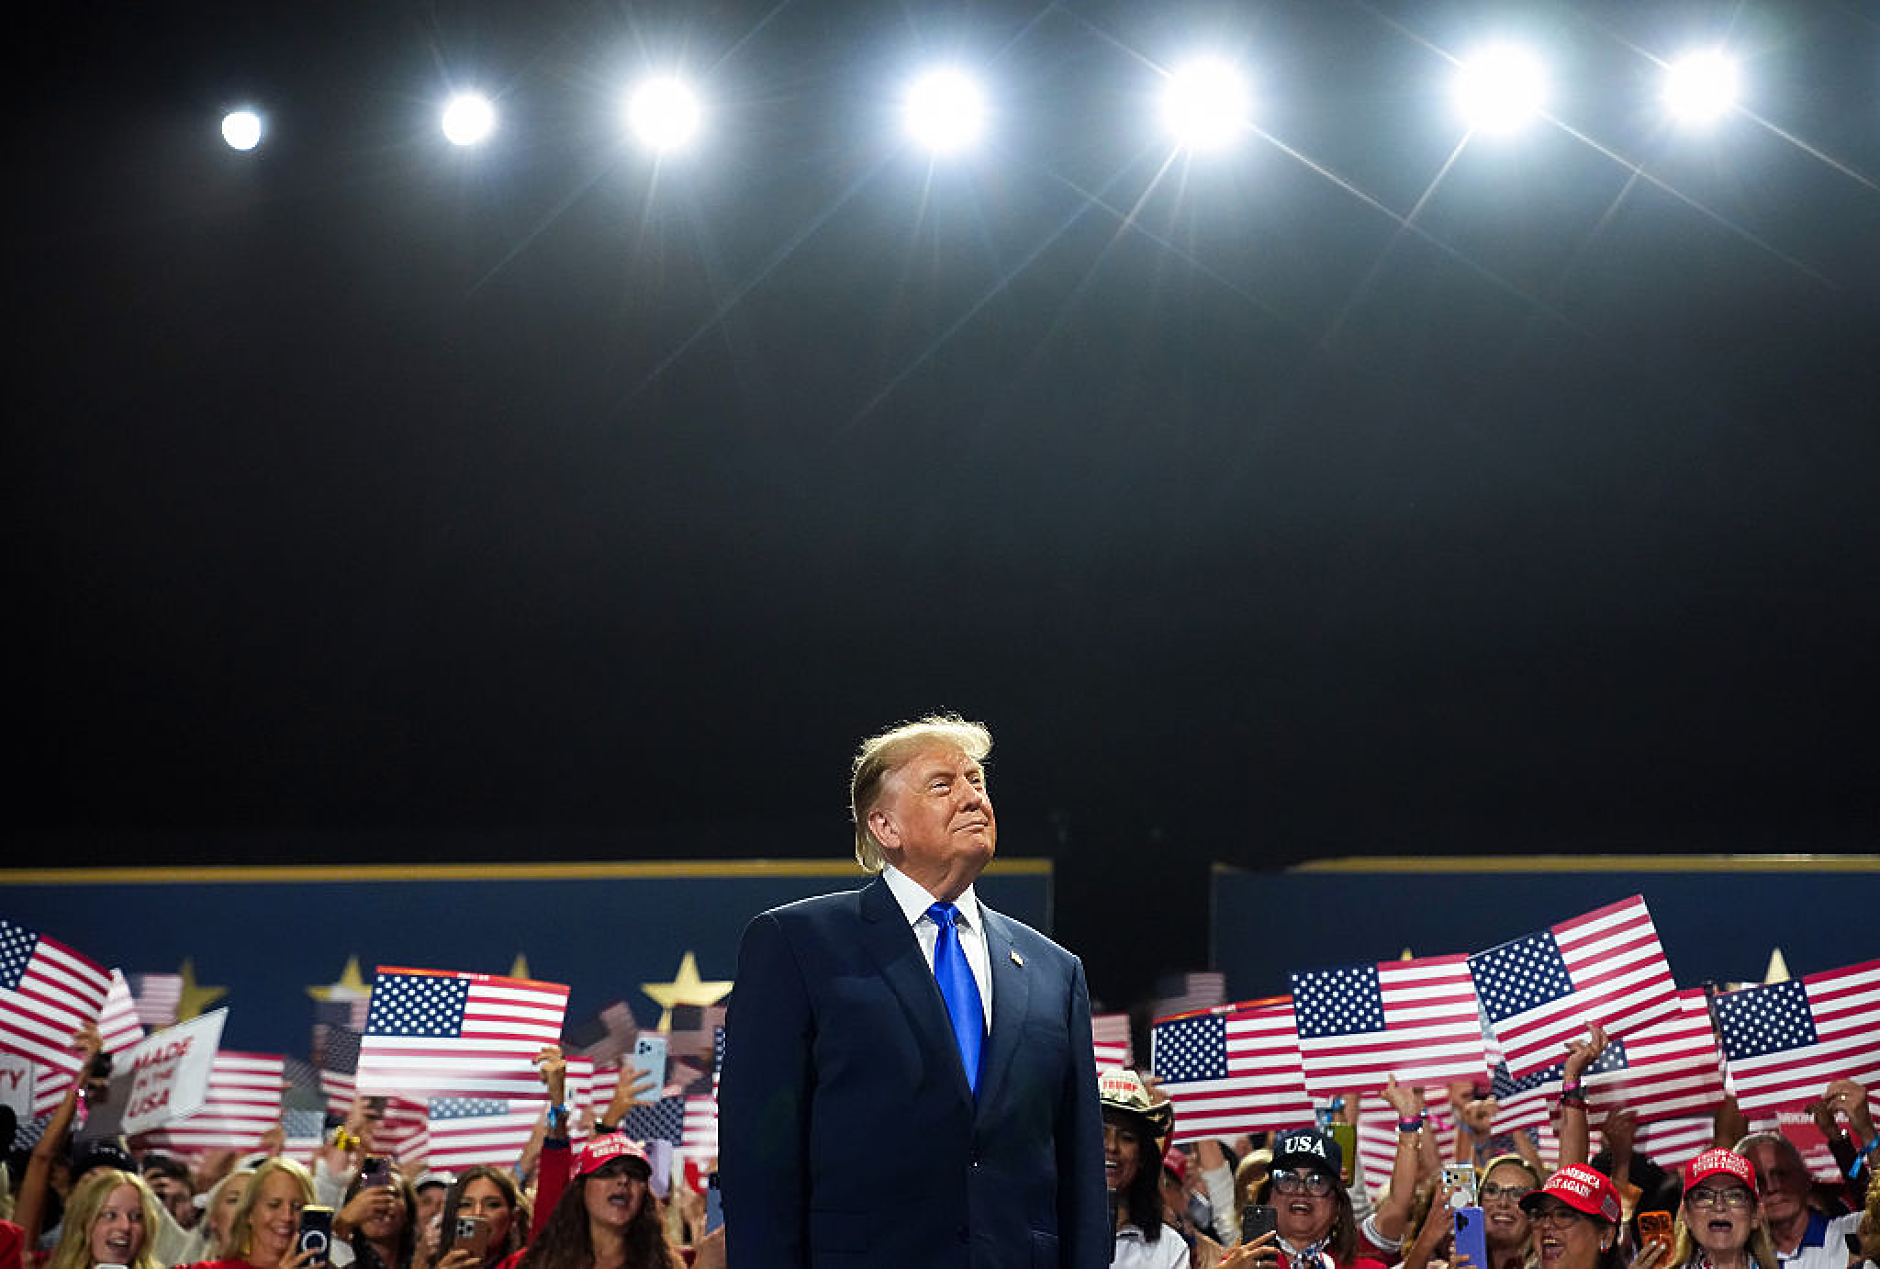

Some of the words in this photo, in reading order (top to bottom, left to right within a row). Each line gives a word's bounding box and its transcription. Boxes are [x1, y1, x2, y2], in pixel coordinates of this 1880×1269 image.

[131, 1035, 194, 1073] MADE
[1102, 1079, 1139, 1092] TRUMP
[127, 1088, 170, 1118] USA
[1285, 1136, 1327, 1159] USA
